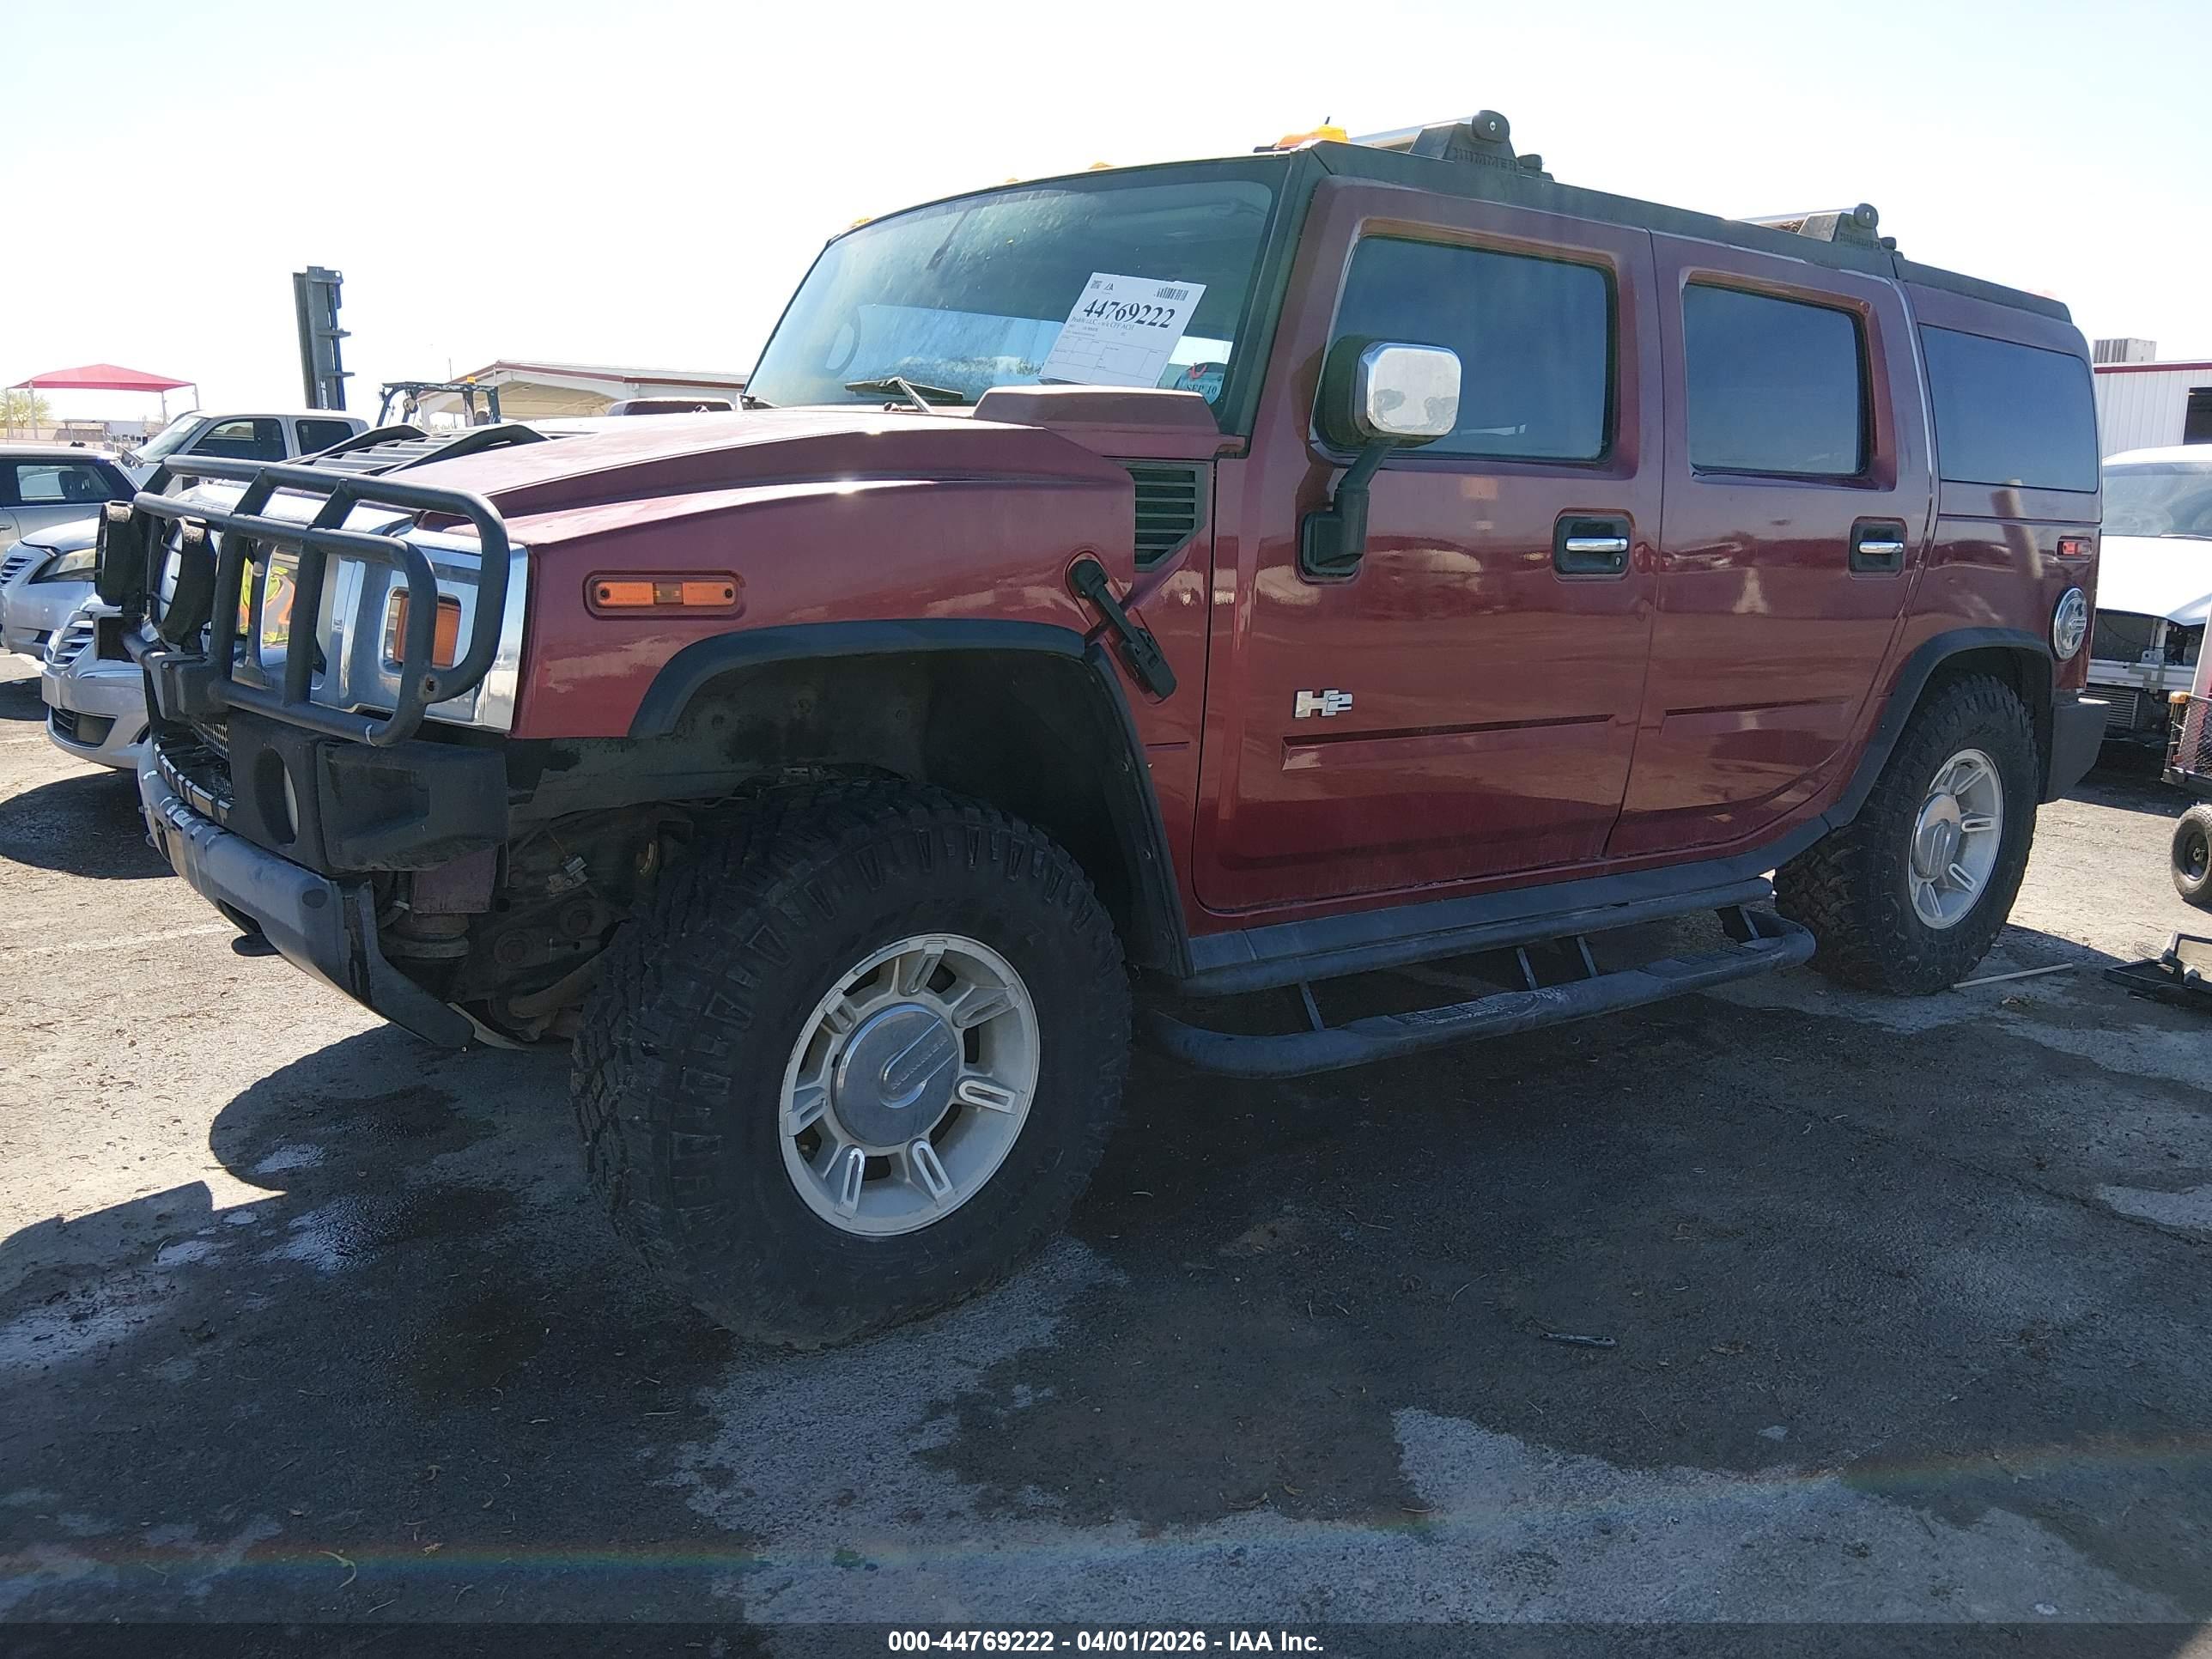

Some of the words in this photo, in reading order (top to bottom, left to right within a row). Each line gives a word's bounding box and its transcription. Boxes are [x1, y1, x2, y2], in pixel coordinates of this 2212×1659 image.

[1454, 147, 1517, 172] HUMMER
[1083, 298, 1176, 329] 44769222
[1207, 385, 1218, 395] 10
[1293, 688, 1354, 719] H2
